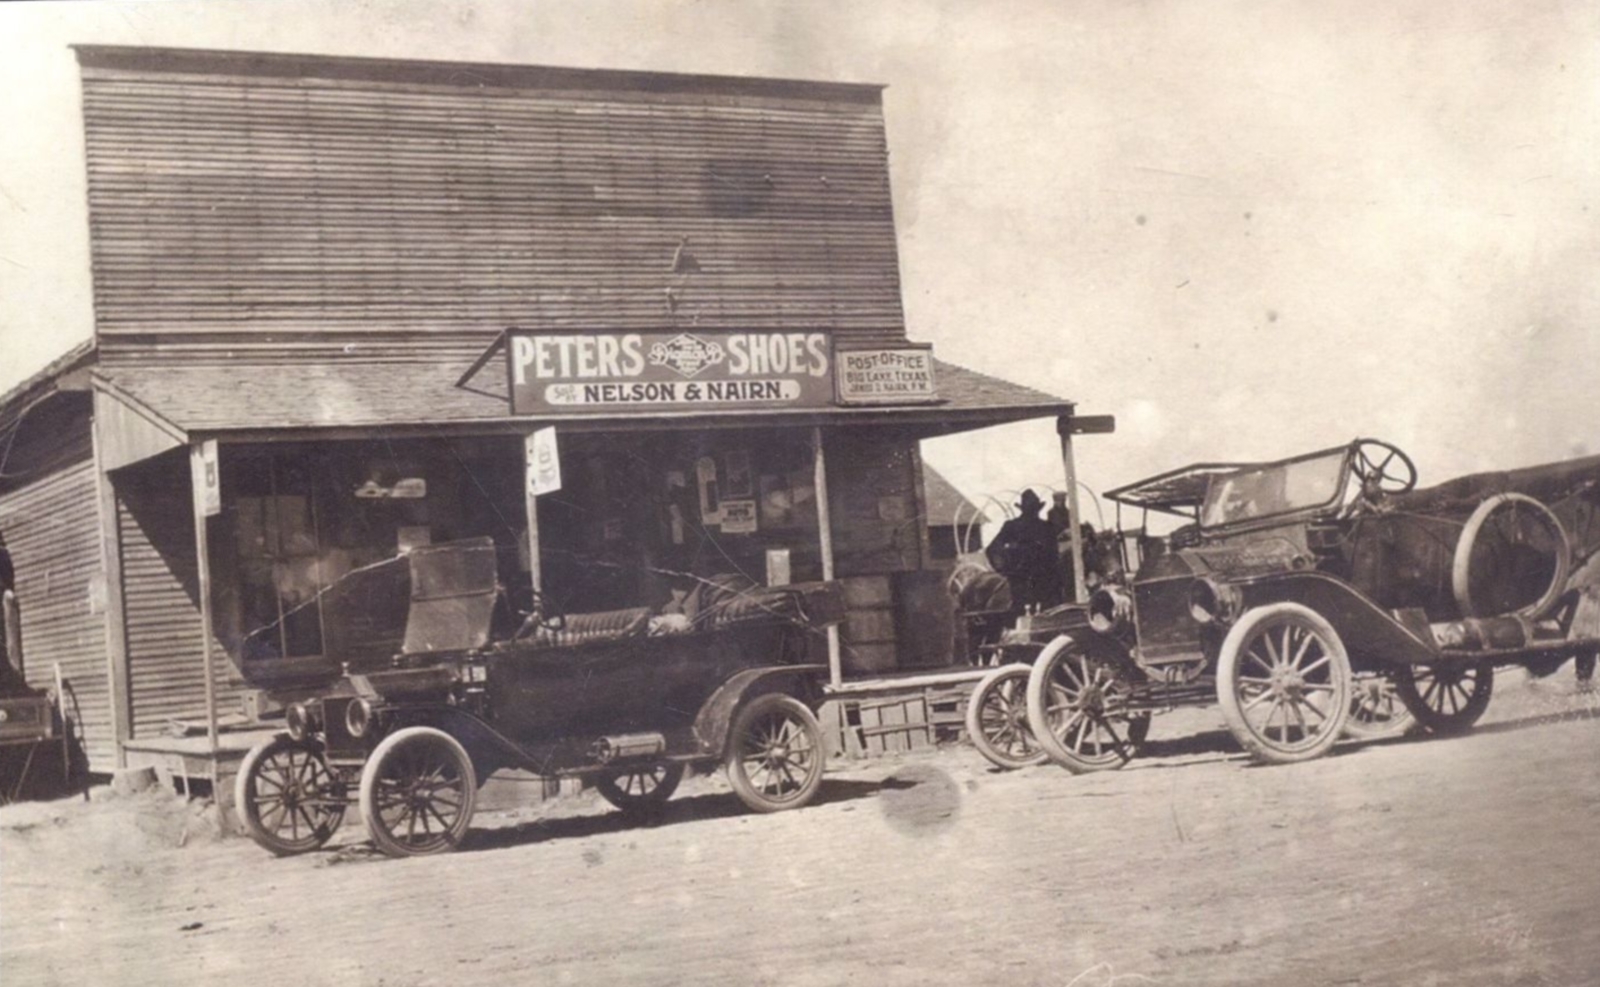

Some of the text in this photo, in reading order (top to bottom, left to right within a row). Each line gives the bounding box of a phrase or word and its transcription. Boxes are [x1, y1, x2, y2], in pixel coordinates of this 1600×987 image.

[511, 334, 645, 384] PETERS
[727, 333, 828, 377] SHOES
[847, 353, 924, 370] POST OFFICE
[584, 384, 676, 402] NELSON
[684, 383, 702, 401] &
